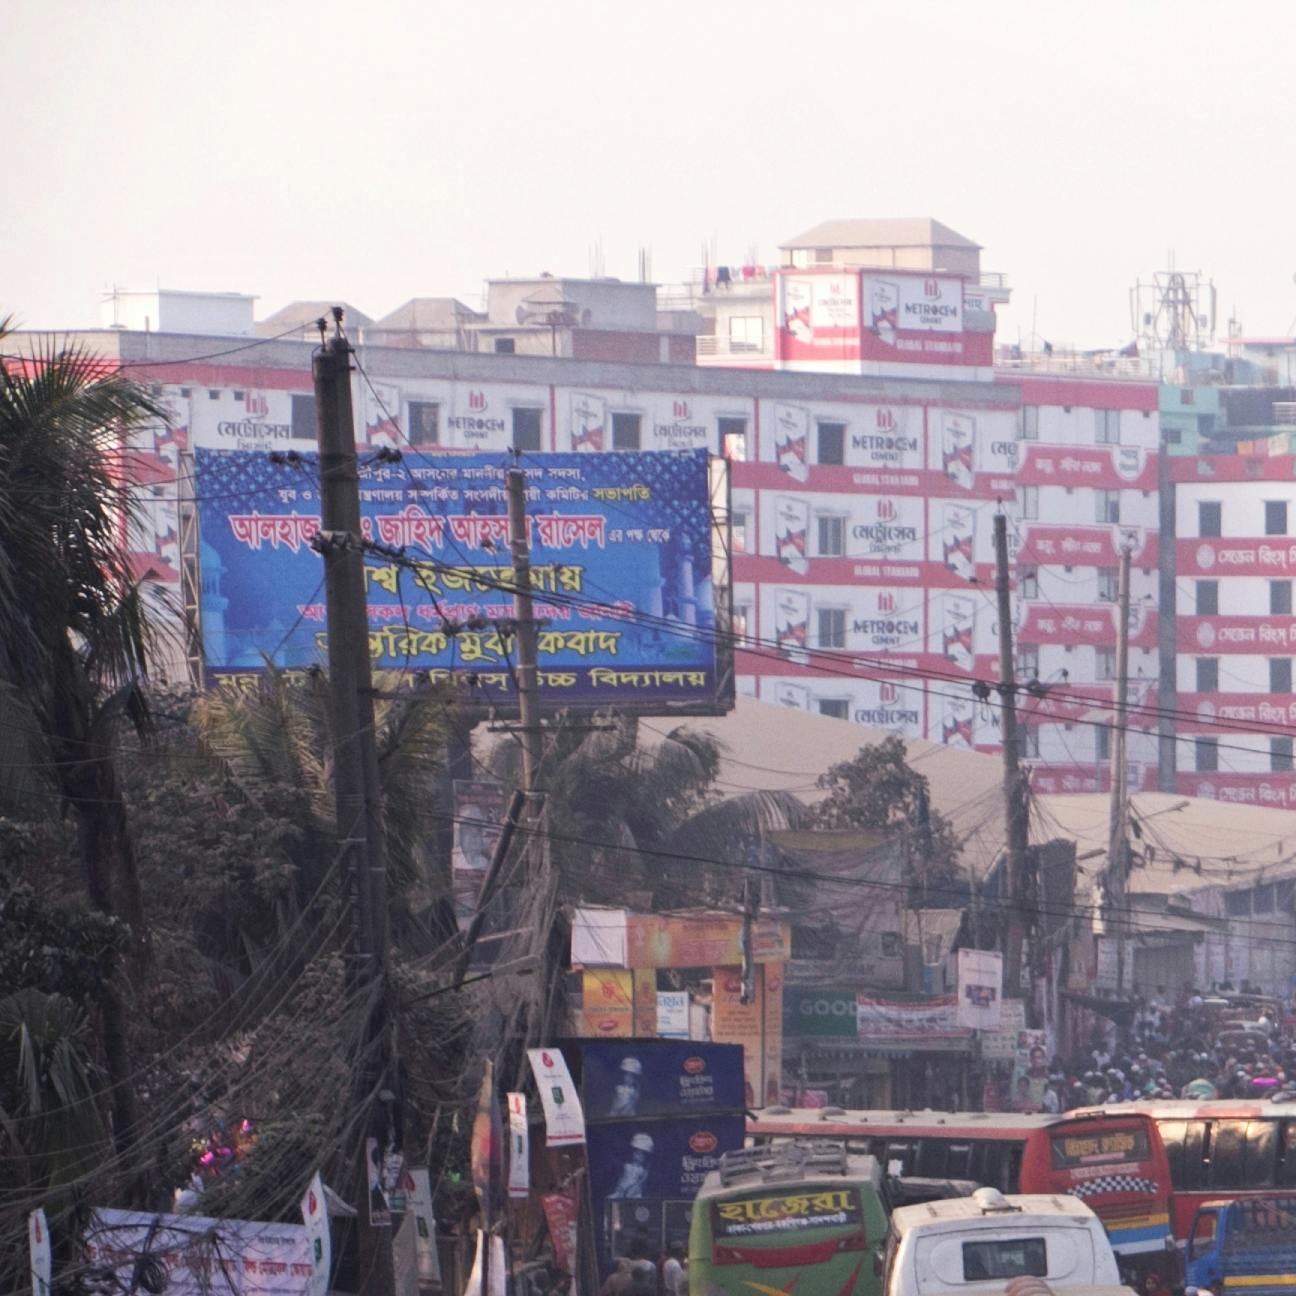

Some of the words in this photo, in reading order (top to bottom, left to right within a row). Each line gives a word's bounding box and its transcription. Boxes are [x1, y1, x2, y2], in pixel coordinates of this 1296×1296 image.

[852, 434, 917, 451] METROCEM
[376, 503, 445, 550] জাহিদ
[536, 510, 607, 550] রাসেল
[853, 620, 918, 634] METROCEM
[457, 629, 623, 662] মুবাকবাদ
[717, 1191, 856, 1222] হাজেরা
